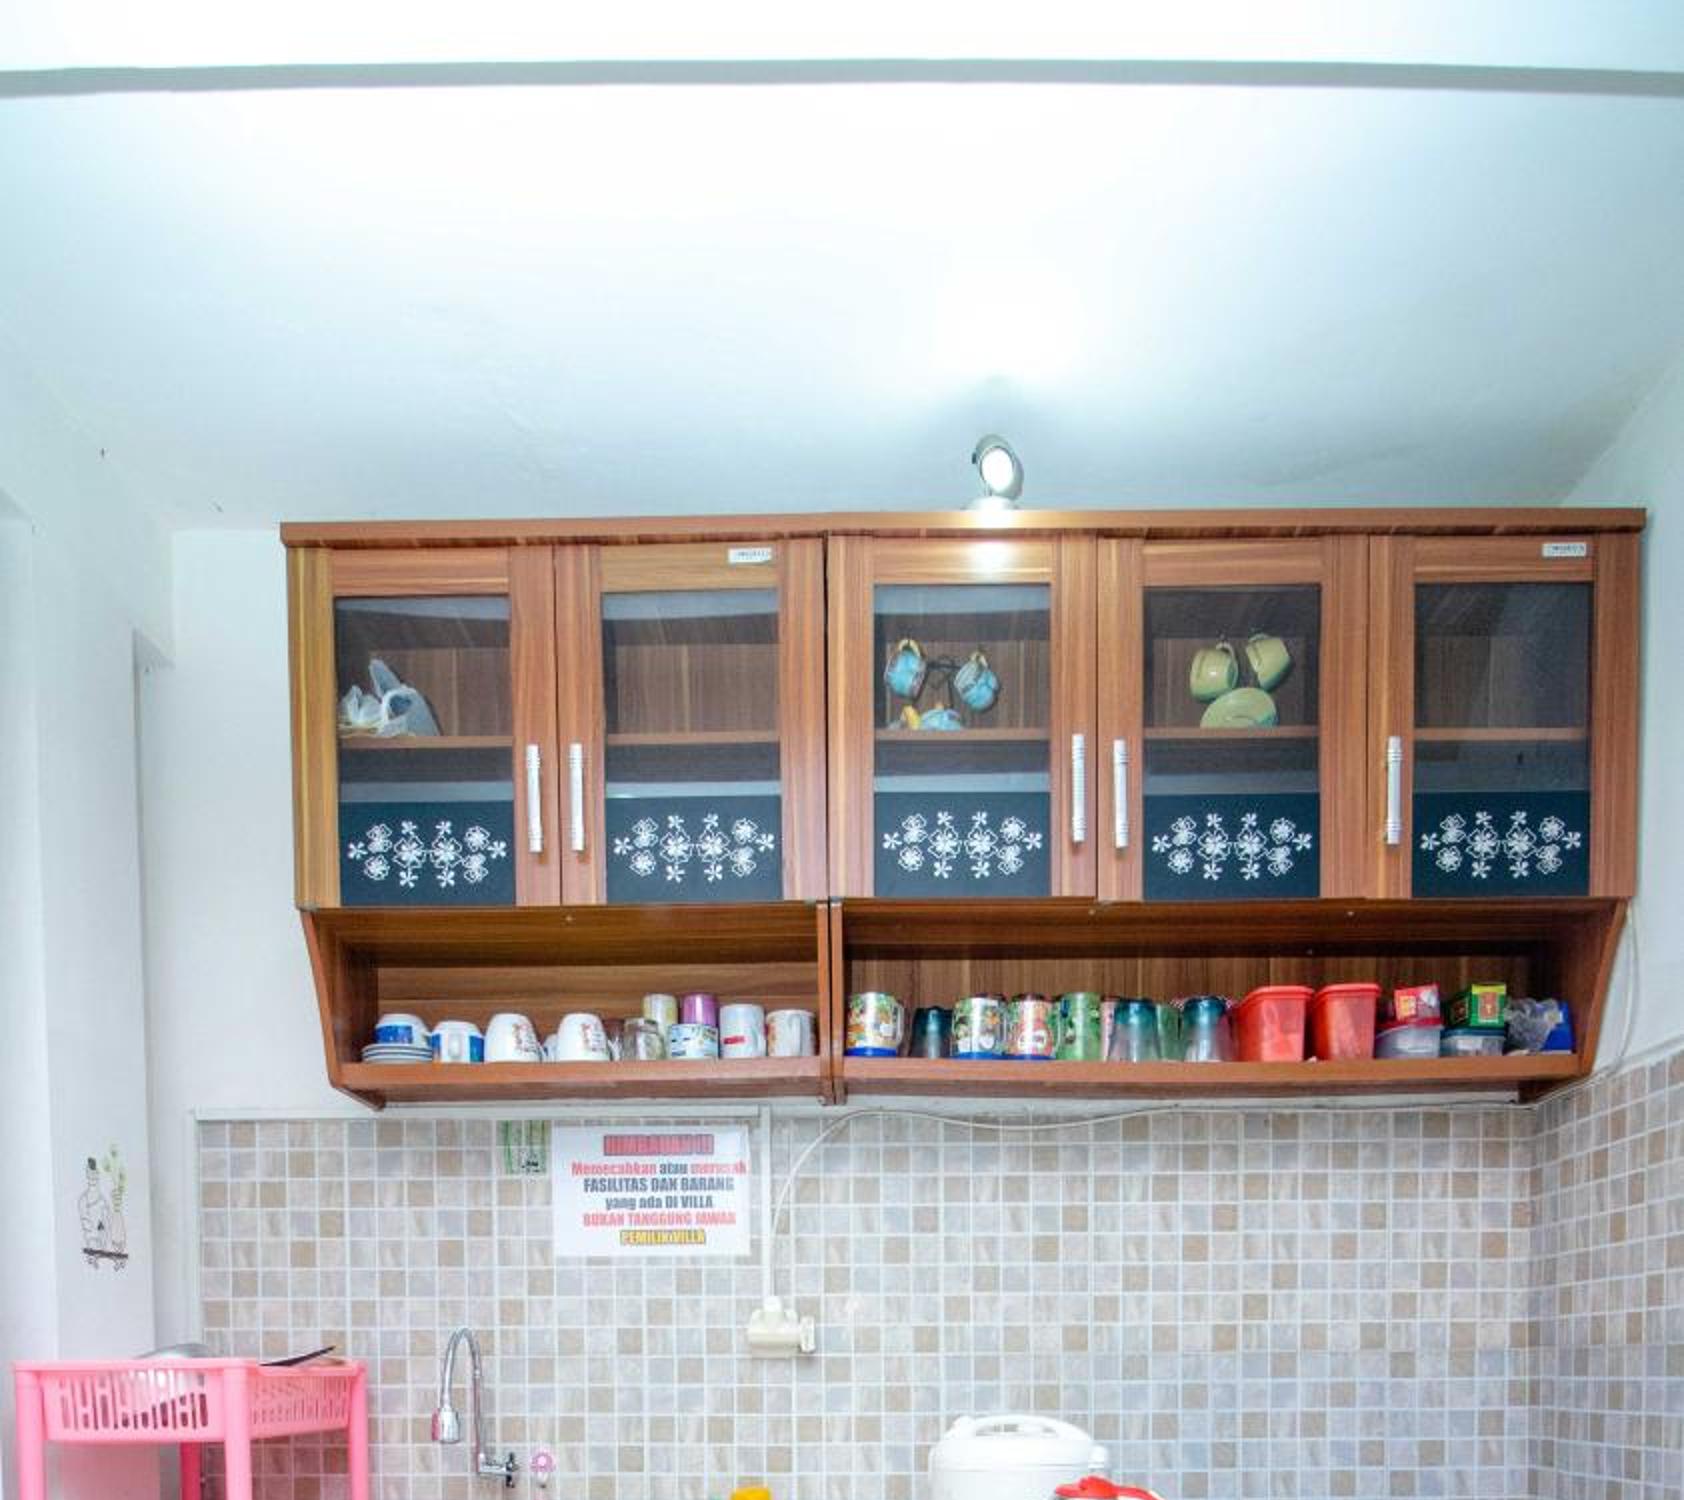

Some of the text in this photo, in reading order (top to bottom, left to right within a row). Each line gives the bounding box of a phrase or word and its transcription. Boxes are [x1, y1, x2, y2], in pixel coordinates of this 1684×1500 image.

[659, 1162, 688, 1174] atau
[584, 1177, 734, 1192] FASILITAS DAN BARANG
[605, 1196, 713, 1210] yang ada DI VILLA
[583, 1213, 624, 1227] BUKAN
[627, 1213, 692, 1226] TANGGUNG
